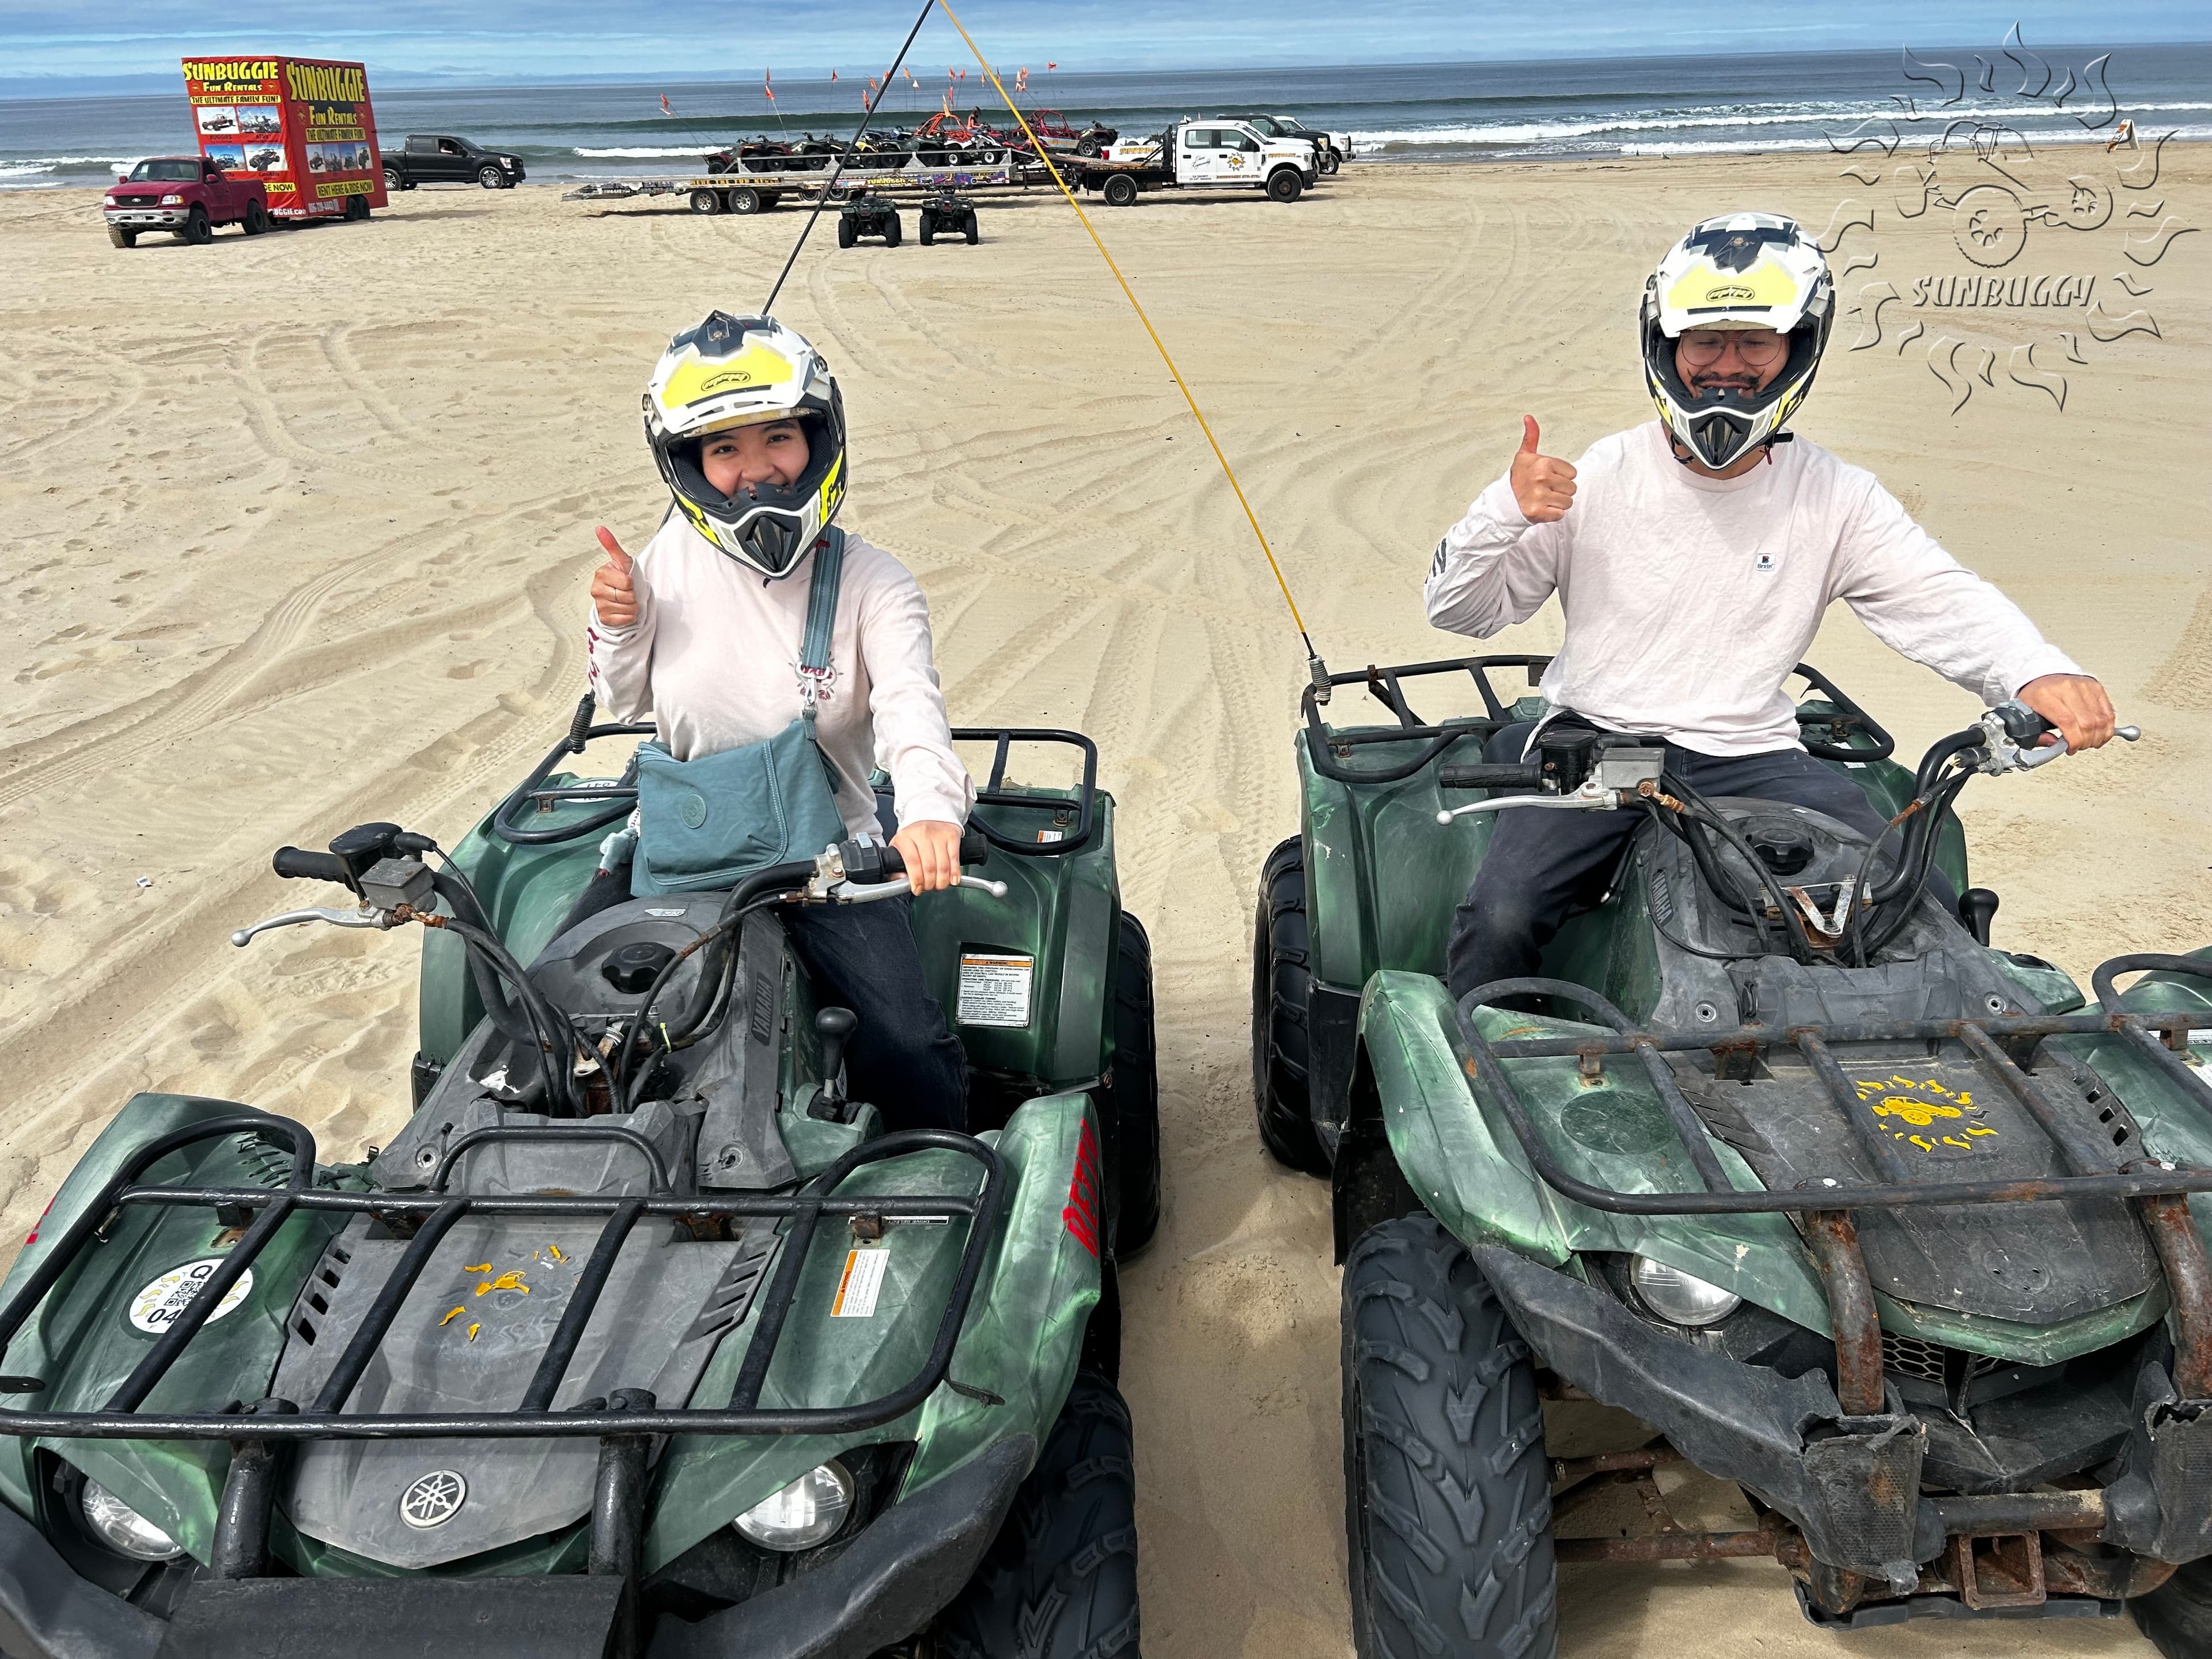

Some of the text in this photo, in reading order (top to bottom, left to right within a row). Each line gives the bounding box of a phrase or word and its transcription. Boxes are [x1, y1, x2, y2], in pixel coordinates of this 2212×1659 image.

[183, 61, 279, 81] SUNBUGGIE
[286, 61, 365, 102] SUNBUGGIE
[317, 185, 331, 196] RENT
[331, 184, 344, 195] HERE
[361, 181, 373, 192] NOW
[1652, 871, 1672, 924] YAMAHA
[752, 979, 772, 1037] YAMAHA
